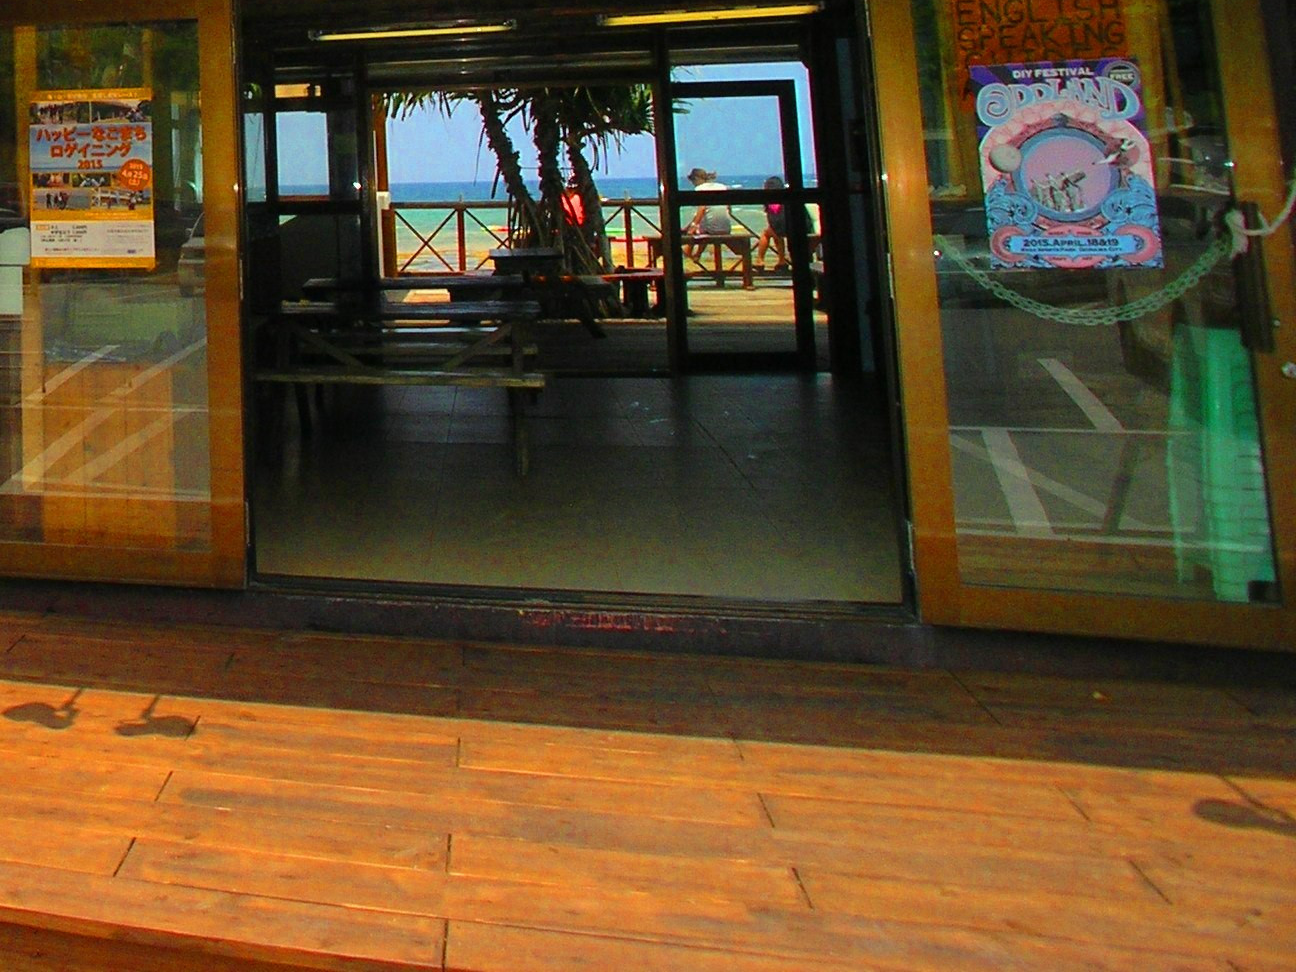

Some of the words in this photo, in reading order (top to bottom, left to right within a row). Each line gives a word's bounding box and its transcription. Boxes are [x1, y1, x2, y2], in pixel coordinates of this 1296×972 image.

[957, 20, 1125, 51] SPEAKING
[1012, 69, 1033, 79] DIY
[1035, 66, 1095, 78] FESTIVAL
